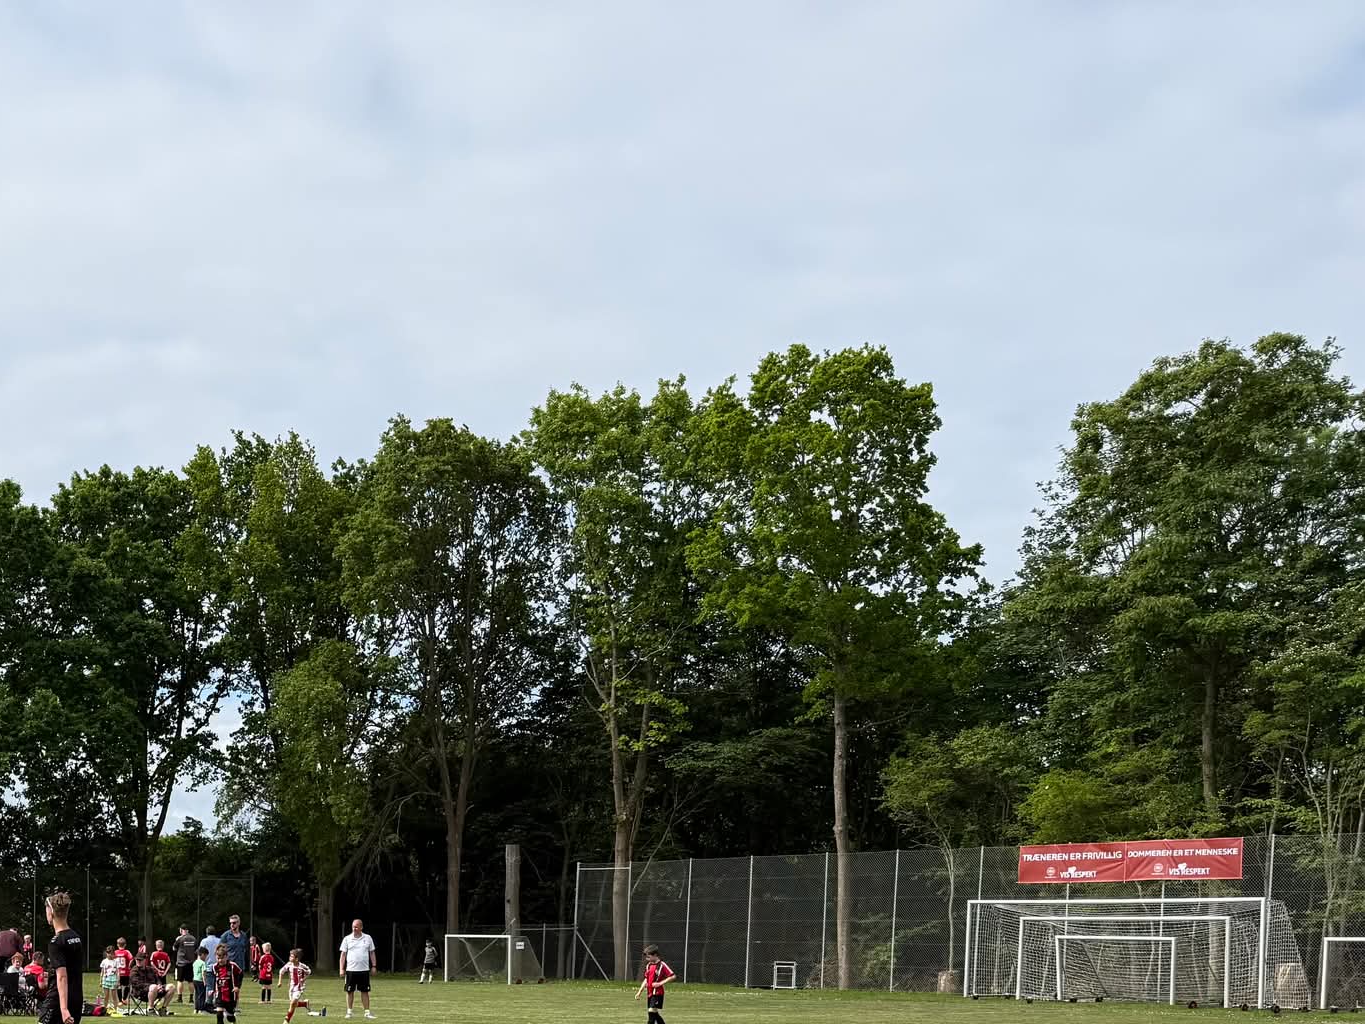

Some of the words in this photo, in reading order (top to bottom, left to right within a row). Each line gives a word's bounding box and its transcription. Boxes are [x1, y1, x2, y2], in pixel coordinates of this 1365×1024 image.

[1022, 852, 1069, 862] TRÆNEREN
[1070, 852, 1081, 861] ER
[1082, 850, 1123, 860] FRIVILLIG
[1127, 849, 1173, 858] DOMMEREN
[1173, 849, 1184, 857] ER
[1184, 849, 1194, 857] ET
[1195, 847, 1239, 856] MENNESKE
[1168, 867, 1181, 876] VIS
[1181, 867, 1210, 876] RESPEKT
[156, 959, 166, 970] 10
[266, 962, 272, 973] 3
